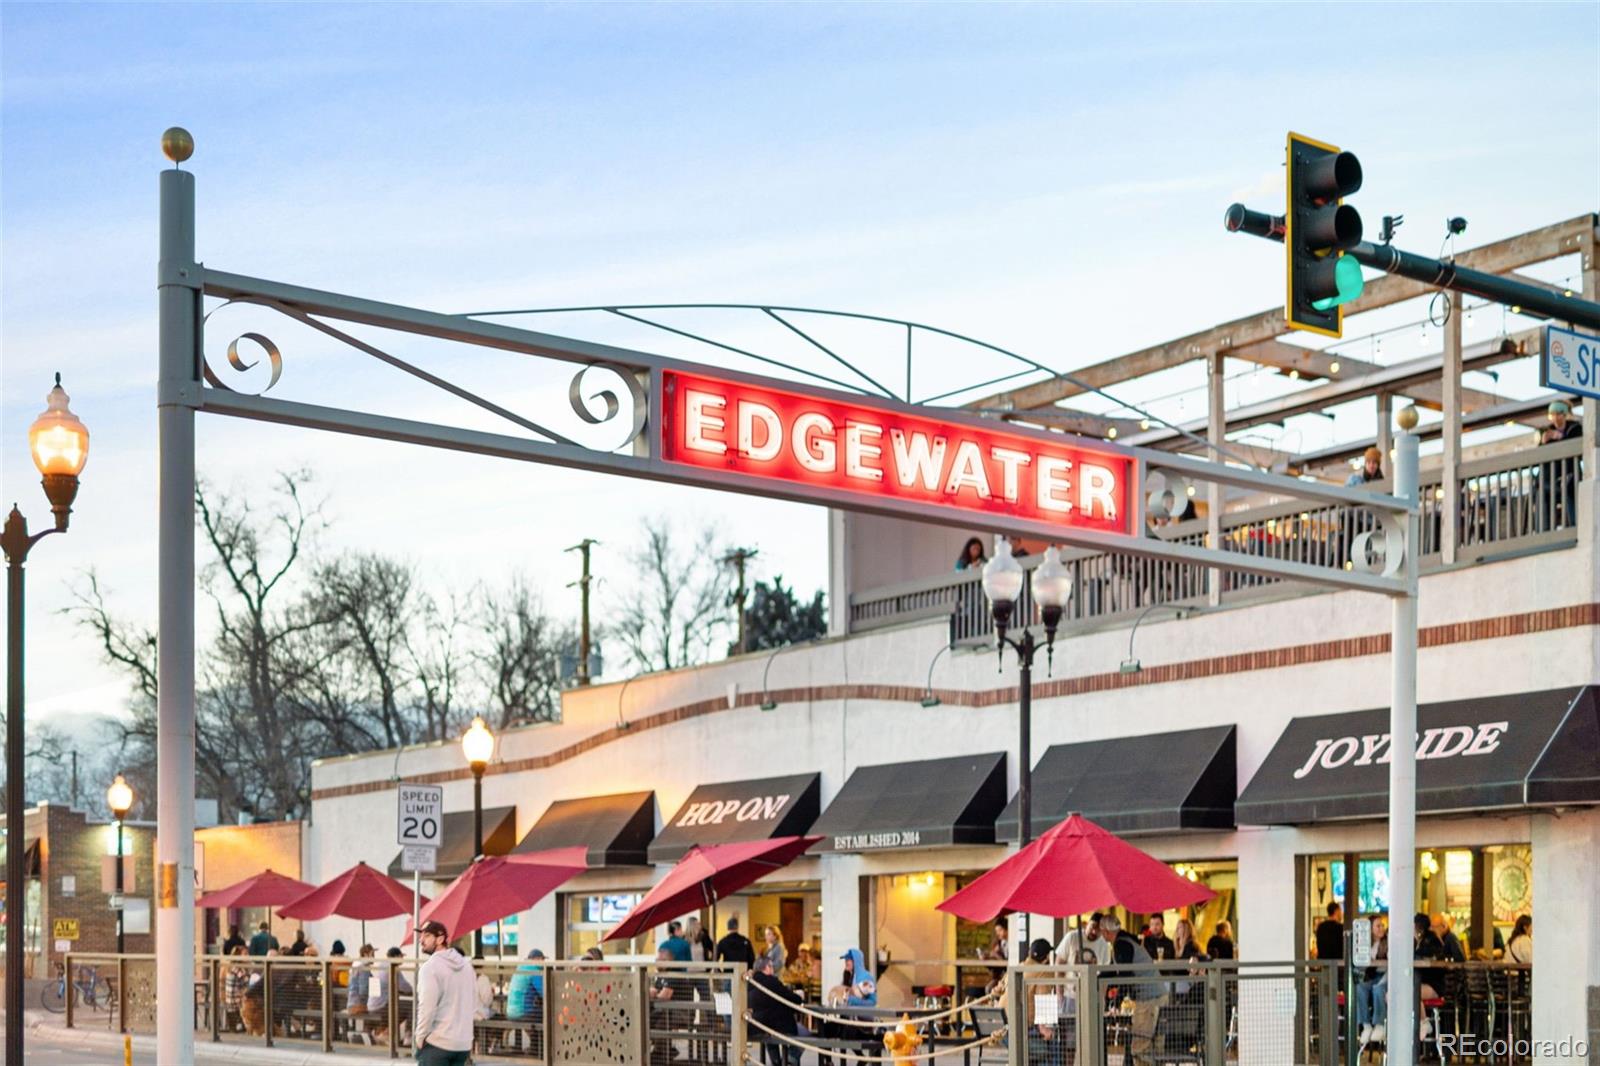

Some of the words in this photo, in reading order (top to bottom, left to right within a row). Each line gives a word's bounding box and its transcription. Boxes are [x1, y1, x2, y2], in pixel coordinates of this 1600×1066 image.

[684, 389, 1117, 521] EDGEWATER
[402, 791, 439, 802] SPEED
[406, 804, 434, 814] LIMIT
[675, 801, 741, 827] HOP
[736, 794, 790, 822] ON!
[403, 817, 437, 839] 20
[834, 833, 900, 850] ESTABLISHED
[55, 920, 77, 931] ATM
